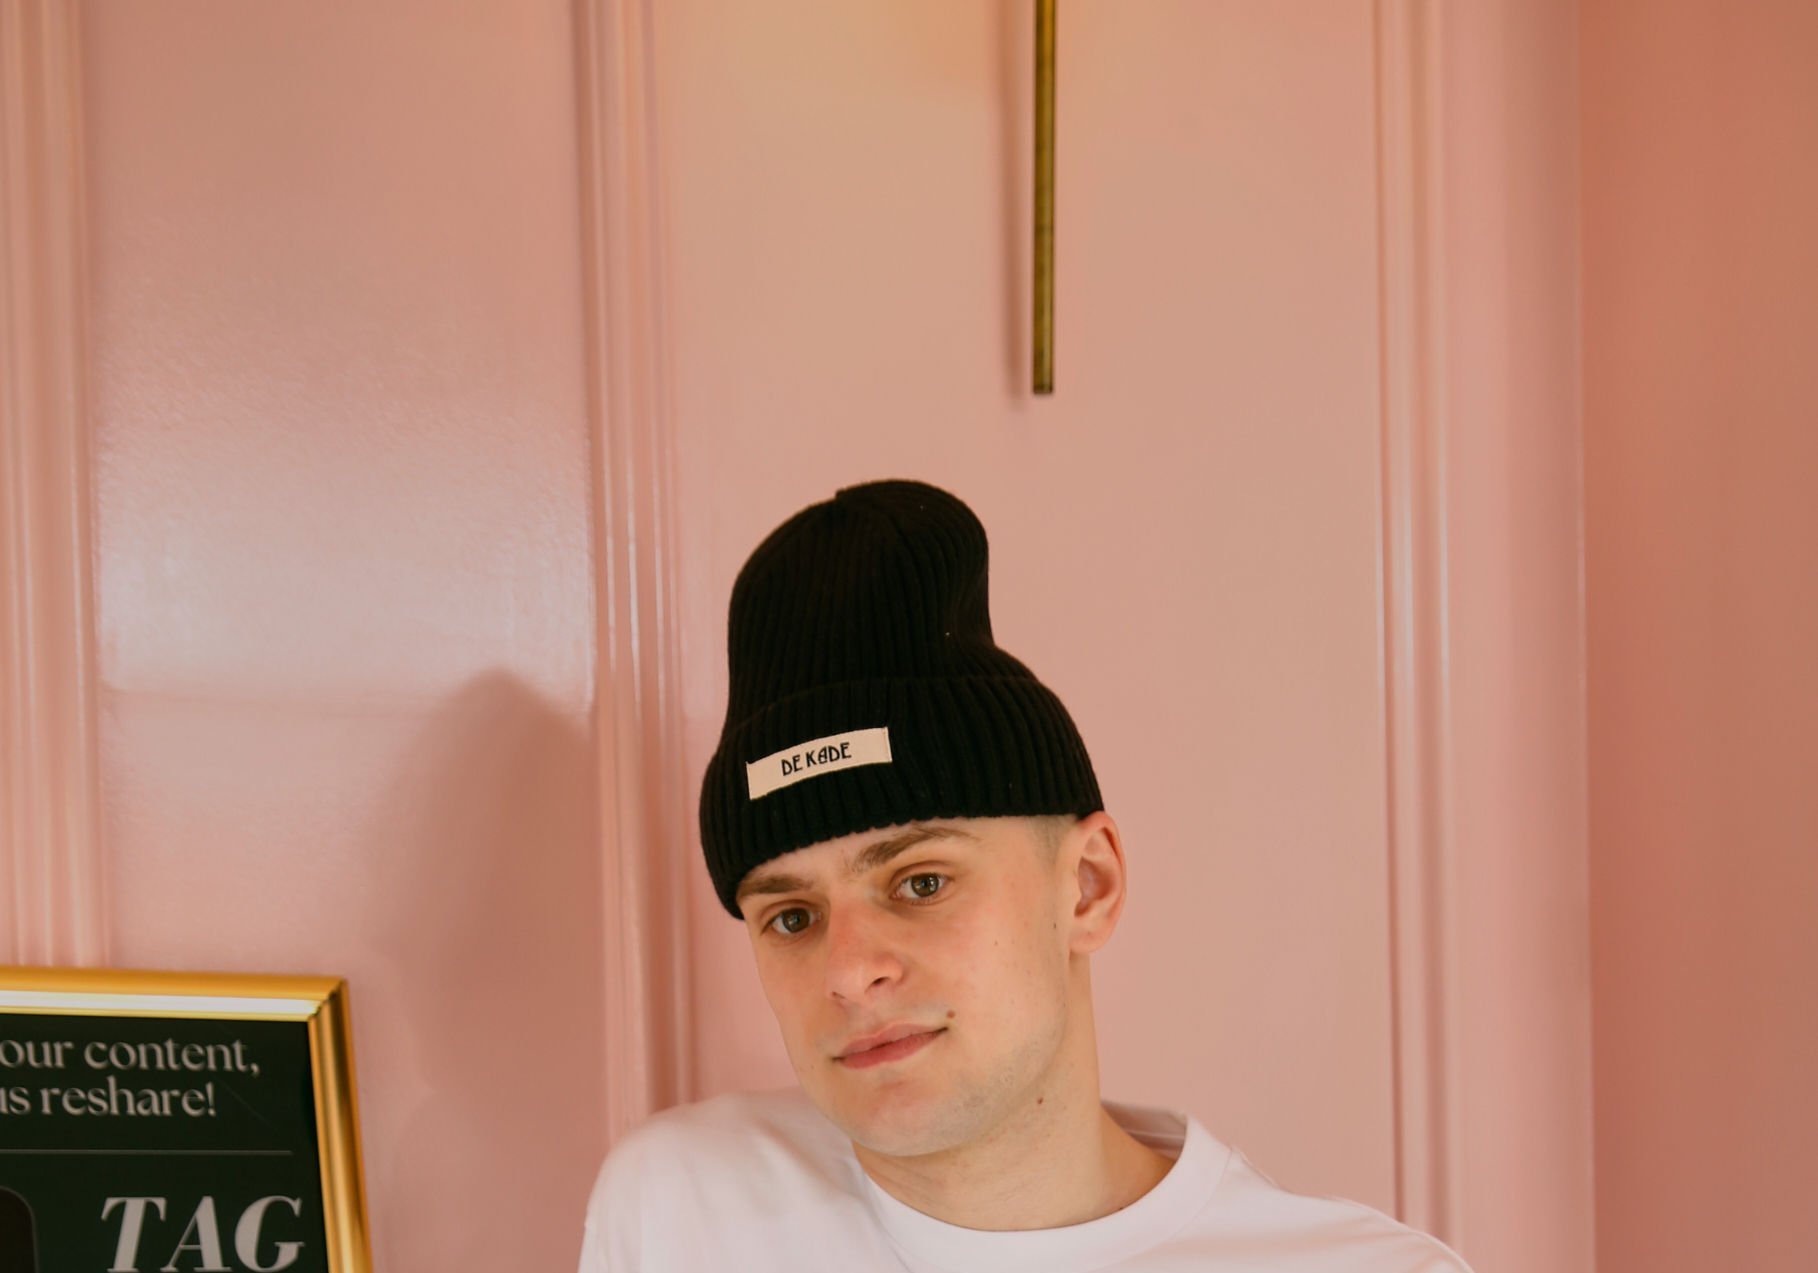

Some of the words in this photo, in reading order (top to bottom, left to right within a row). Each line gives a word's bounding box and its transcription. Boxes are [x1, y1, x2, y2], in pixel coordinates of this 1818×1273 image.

[781, 754, 803, 776] DE
[806, 742, 852, 768] KADE
[84, 1038, 259, 1076] content,
[40, 1075, 216, 1117] reshare!
[101, 1195, 304, 1273] TAG
